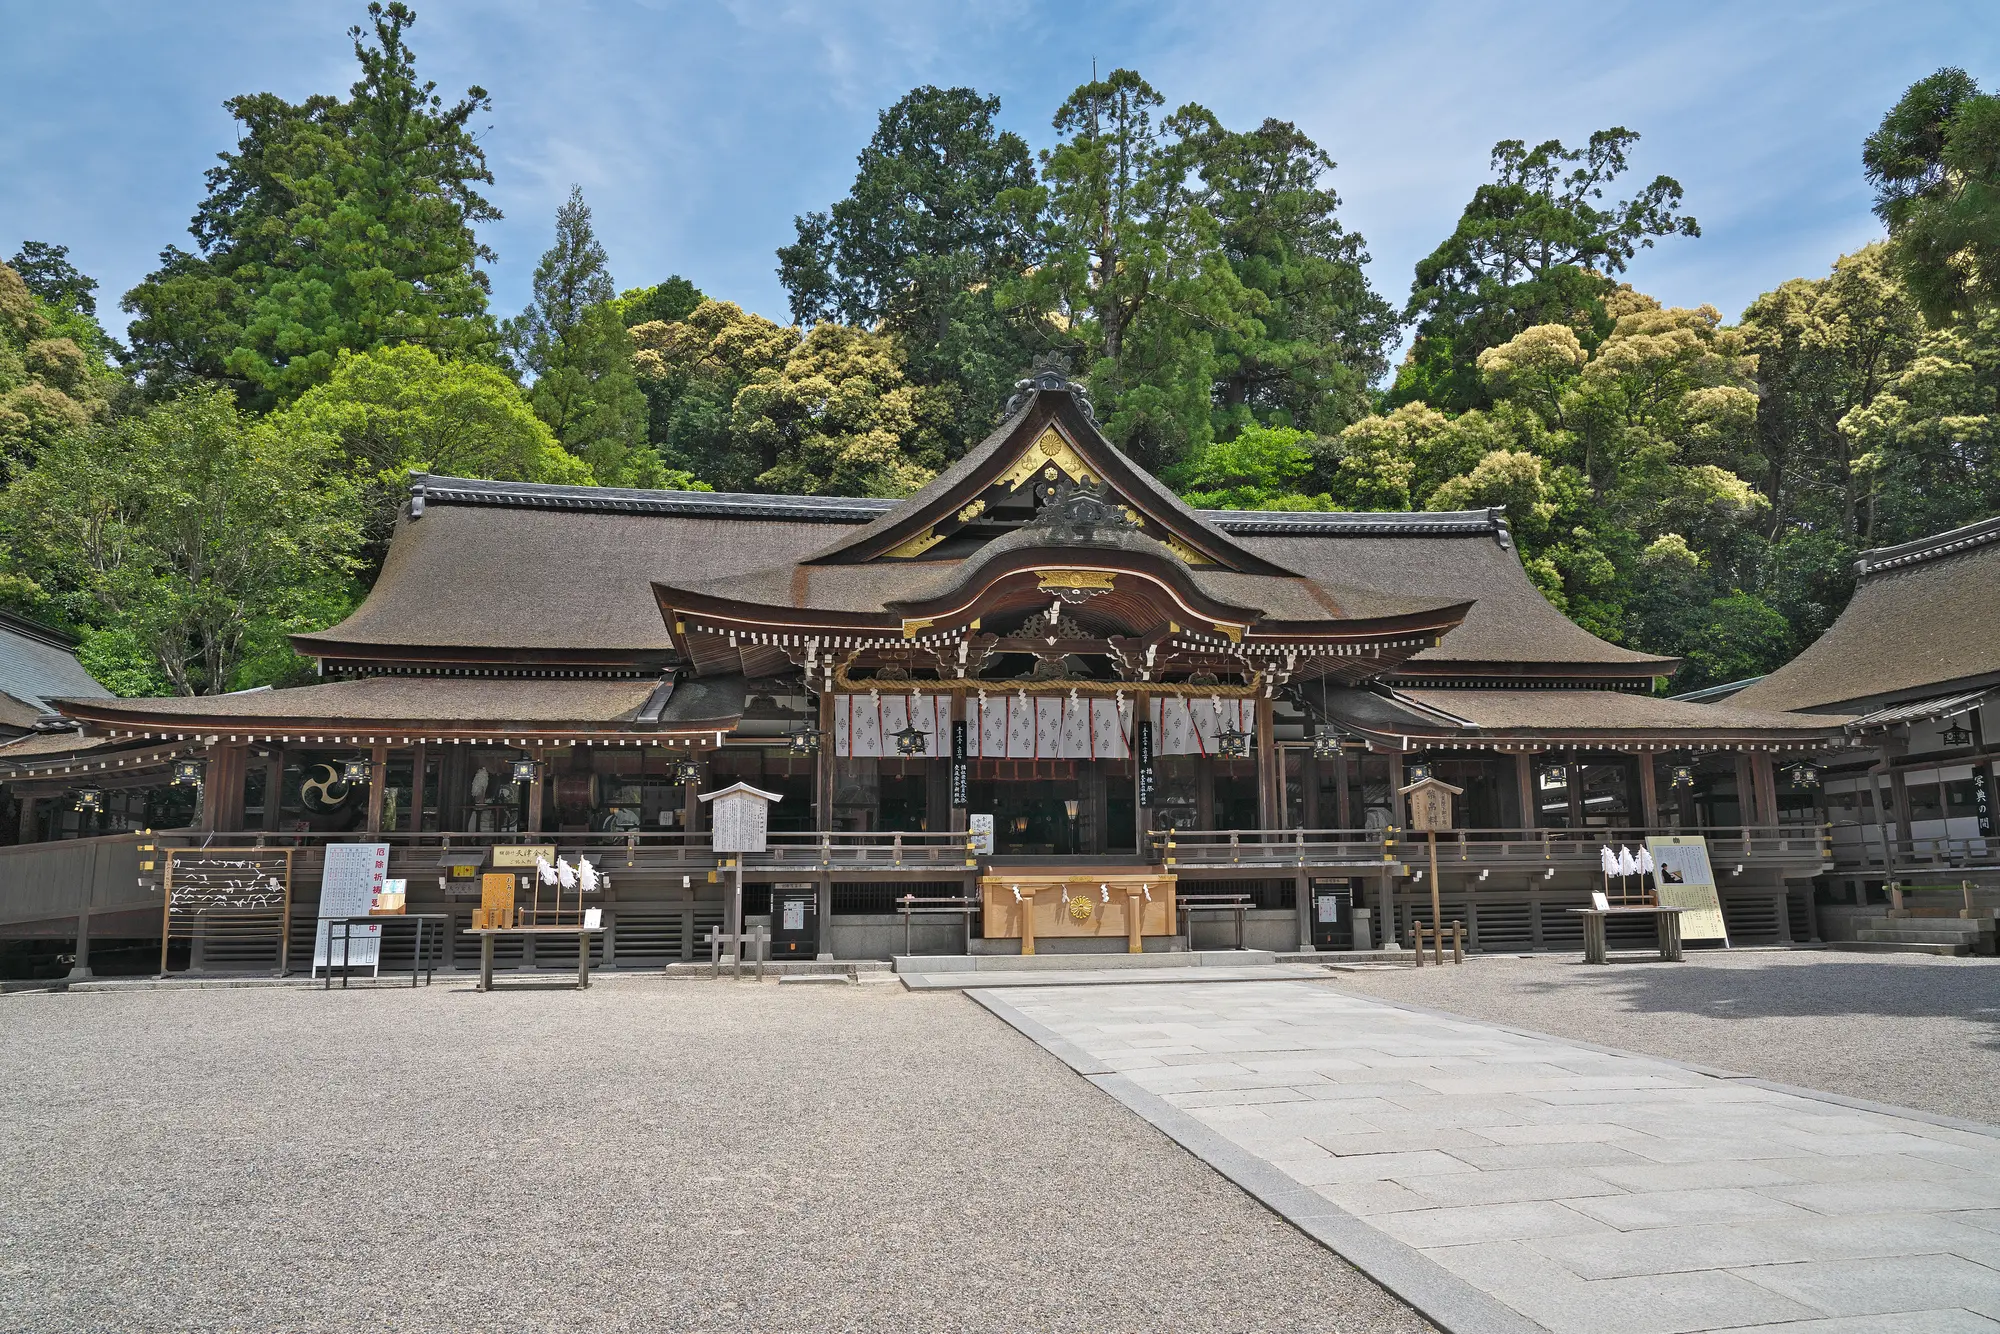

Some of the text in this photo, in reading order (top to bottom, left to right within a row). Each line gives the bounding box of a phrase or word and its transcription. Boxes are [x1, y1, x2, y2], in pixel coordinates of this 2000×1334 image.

[1974, 775, 1990, 829] 写典の間
[368, 847, 386, 933] 厄除祈祷受中
[505, 877, 513, 907] おみくじ
